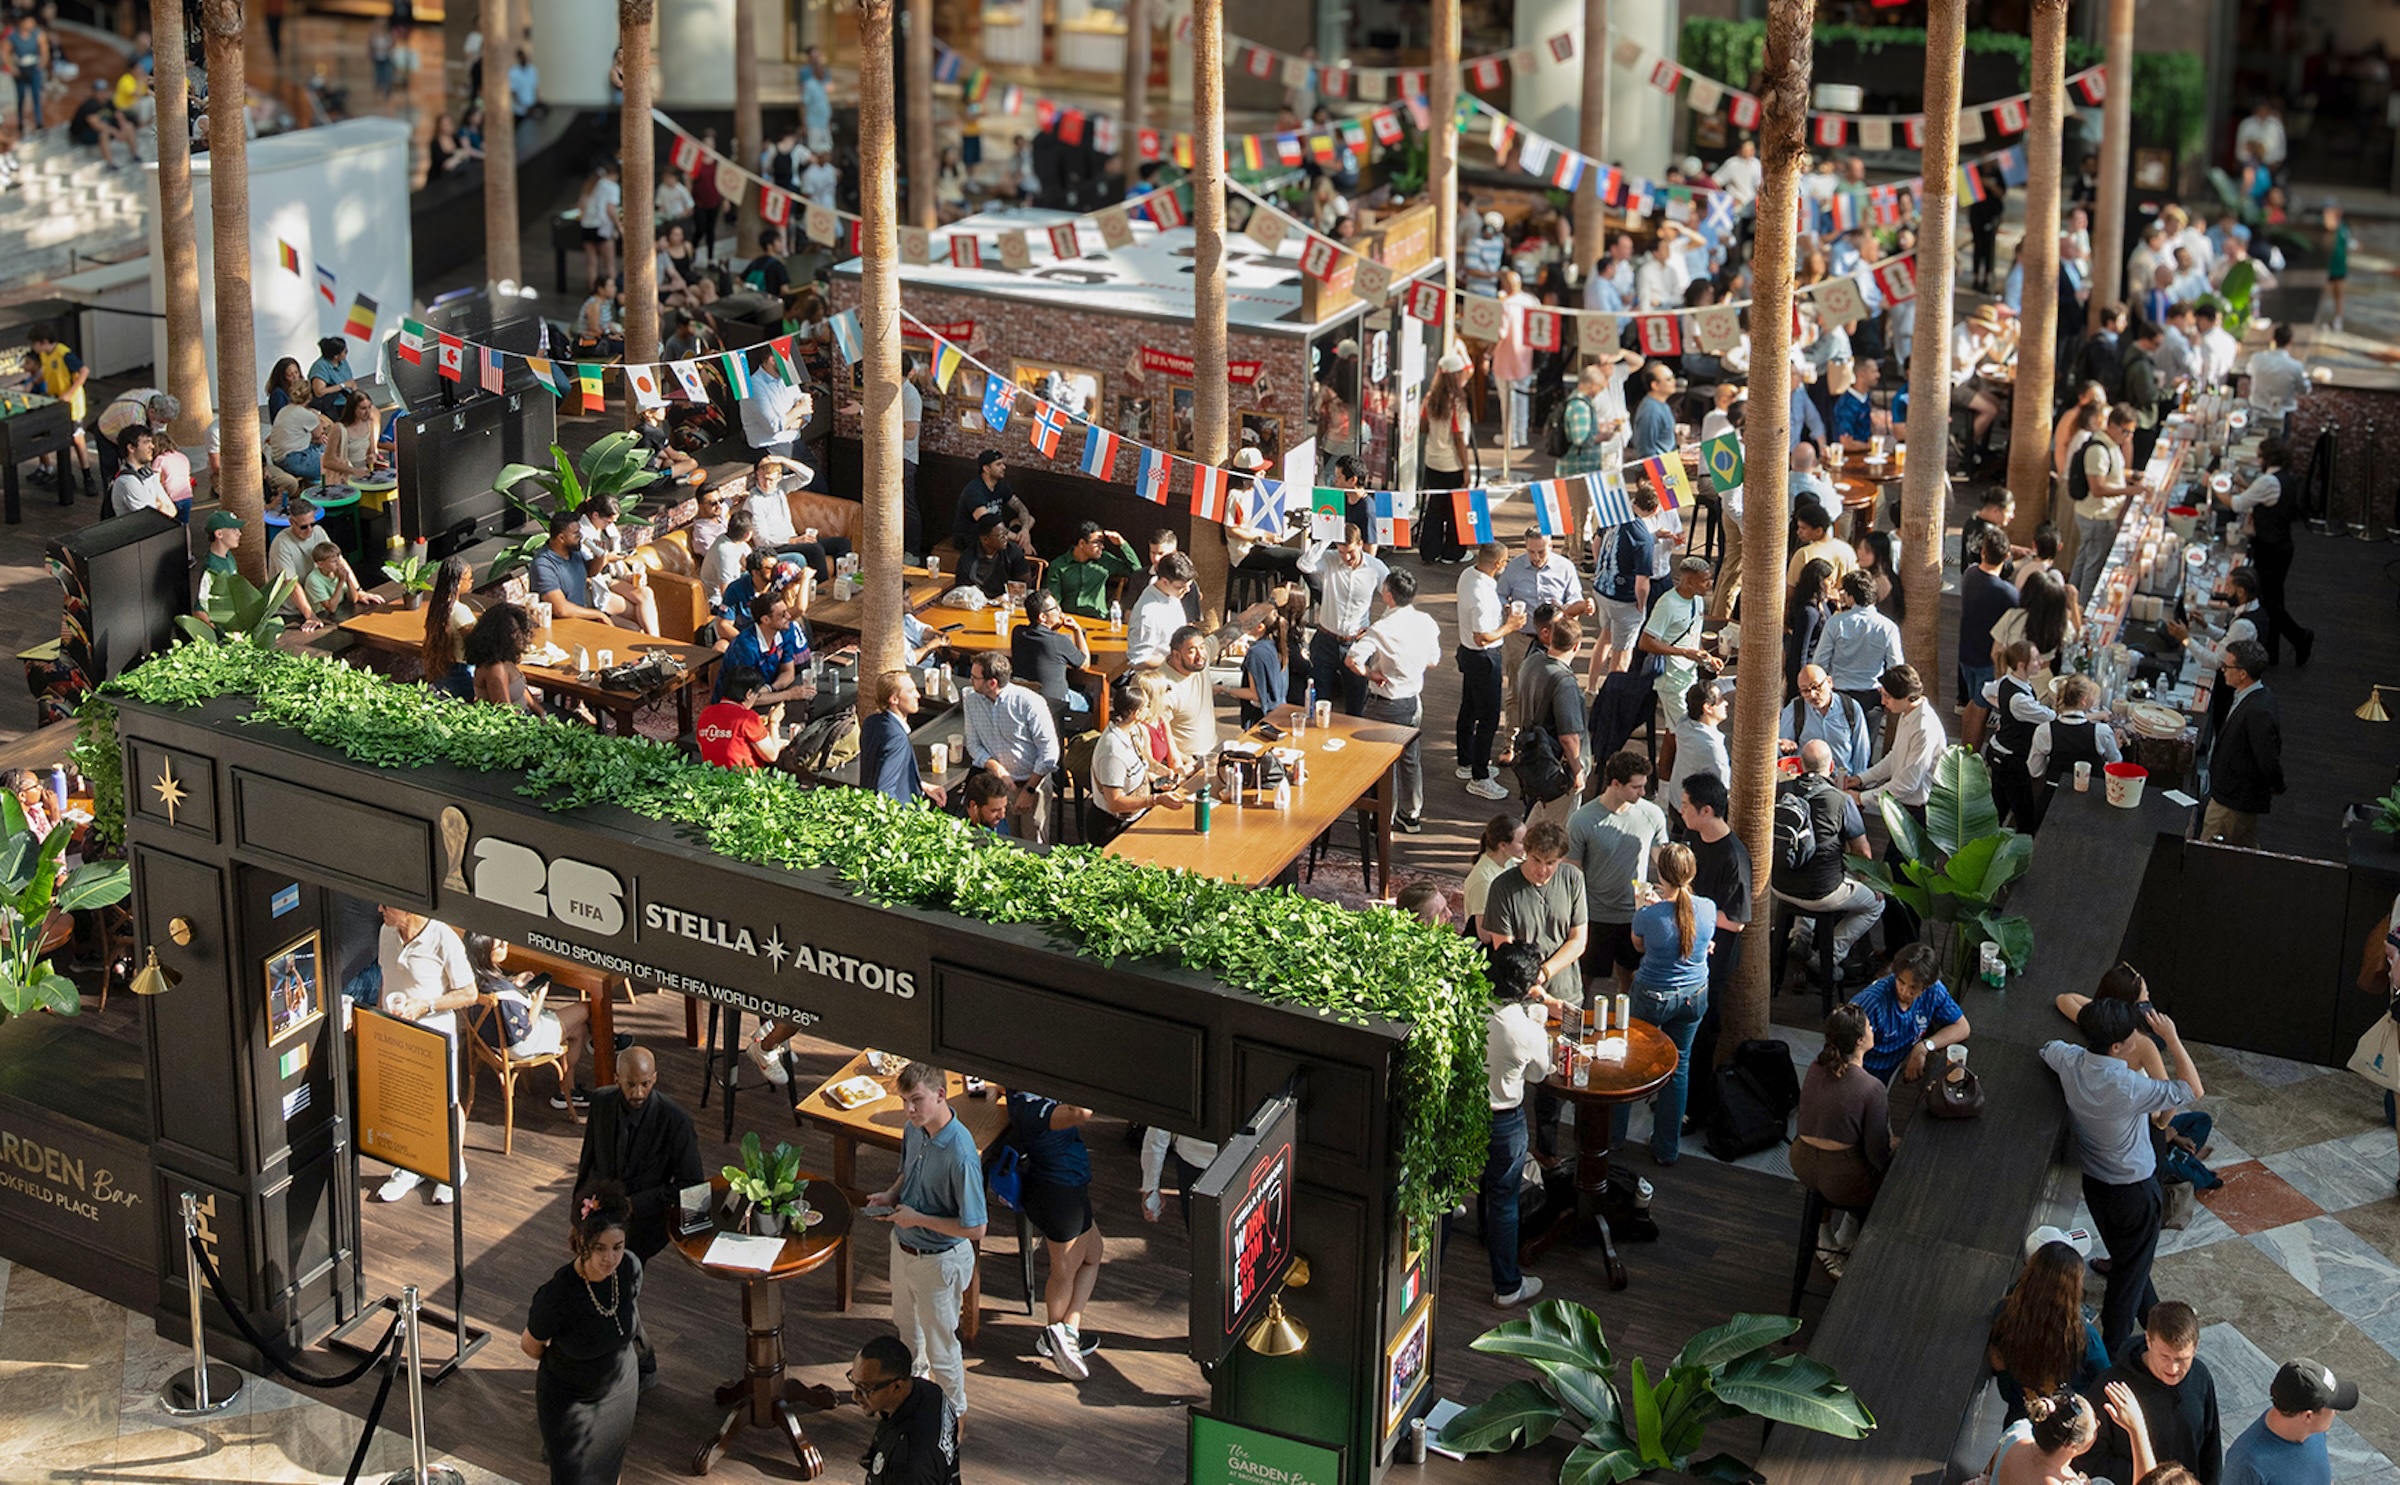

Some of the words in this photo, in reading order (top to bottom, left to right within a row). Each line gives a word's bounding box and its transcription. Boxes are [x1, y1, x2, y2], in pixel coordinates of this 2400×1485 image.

[473, 836, 625, 936] 26
[569, 899, 604, 922] FIFA
[527, 931, 572, 957] PROUD
[571, 944, 633, 975] SPONSOR
[634, 963, 653, 979] OF
[653, 968, 680, 989] THE
[681, 977, 710, 997] FIFA
[710, 984, 760, 1013] WORLD
[761, 1000, 791, 1020] CUP
[645, 902, 758, 957] STELLA
[794, 945, 917, 1000] ARTOIS
[0, 1130, 87, 1193] RDEN
[92, 1168, 143, 1209] Bar
[55, 1192, 100, 1222] PLACE
[1234, 1199, 1267, 1258] WORK
[1234, 1229, 1265, 1287] FROM
[1233, 1269, 1256, 1315] BAR
[1228, 1457, 1289, 1484] GARDEN
